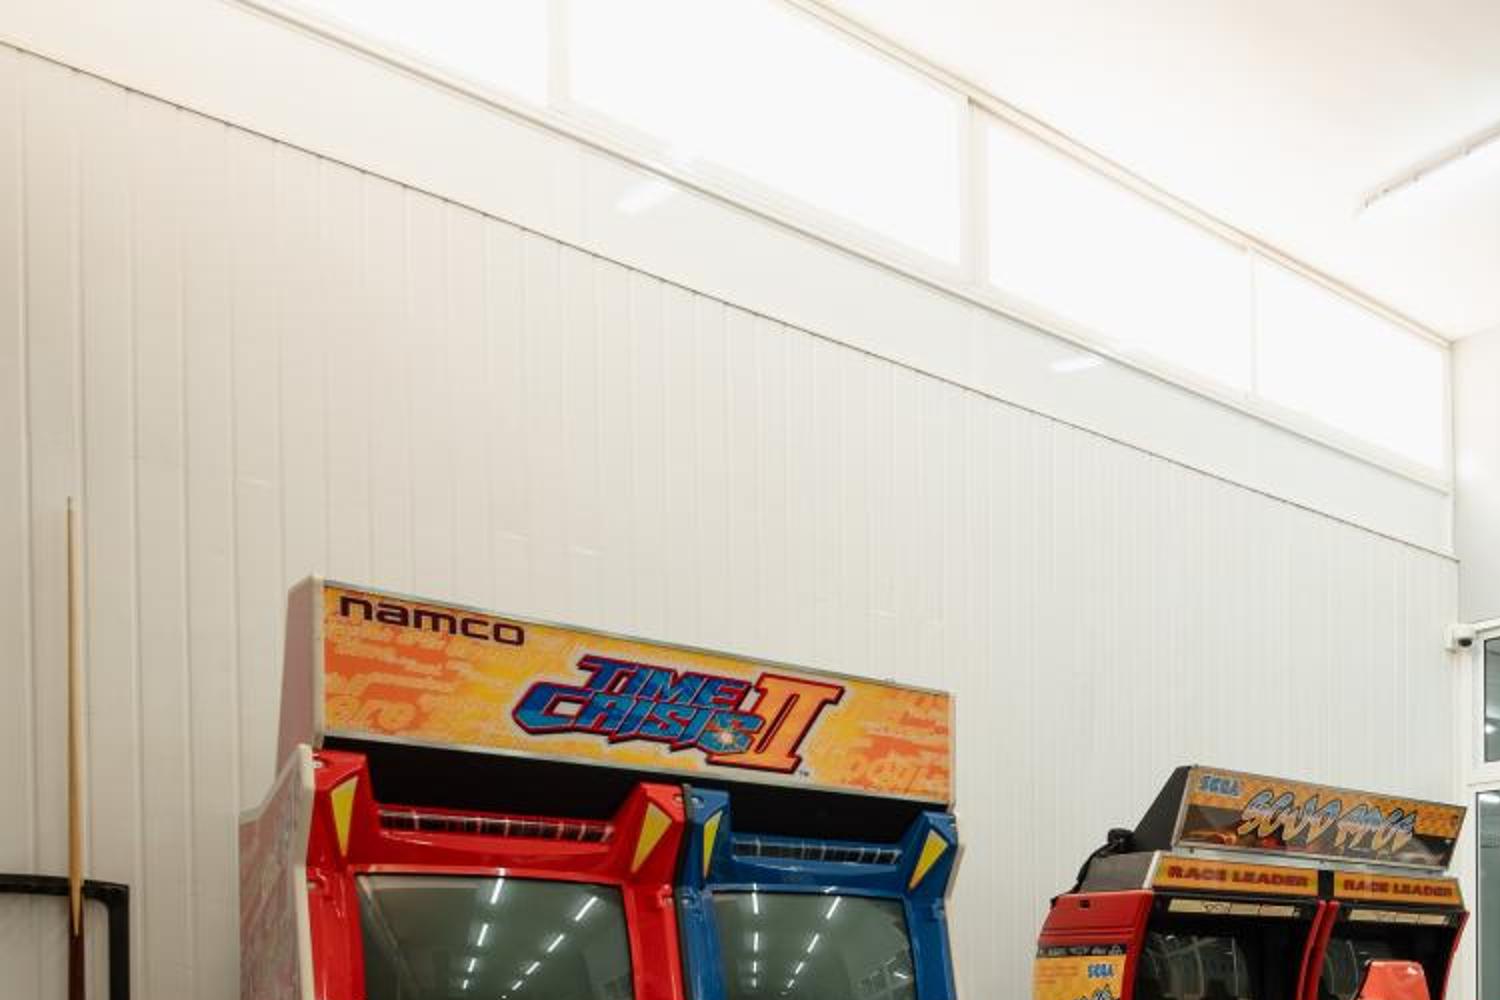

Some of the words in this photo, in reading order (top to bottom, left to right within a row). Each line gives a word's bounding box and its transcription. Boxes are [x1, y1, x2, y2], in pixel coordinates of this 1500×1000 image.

[339, 596, 525, 647] namco
[576, 653, 751, 712] TIME
[511, 681, 766, 755] CRISIS
[705, 671, 846, 774] II
[1167, 865, 1227, 881] RACE
[1231, 869, 1310, 888] LEADER
[1342, 877, 1390, 893] RACE
[1392, 880, 1453, 898] LEADER
